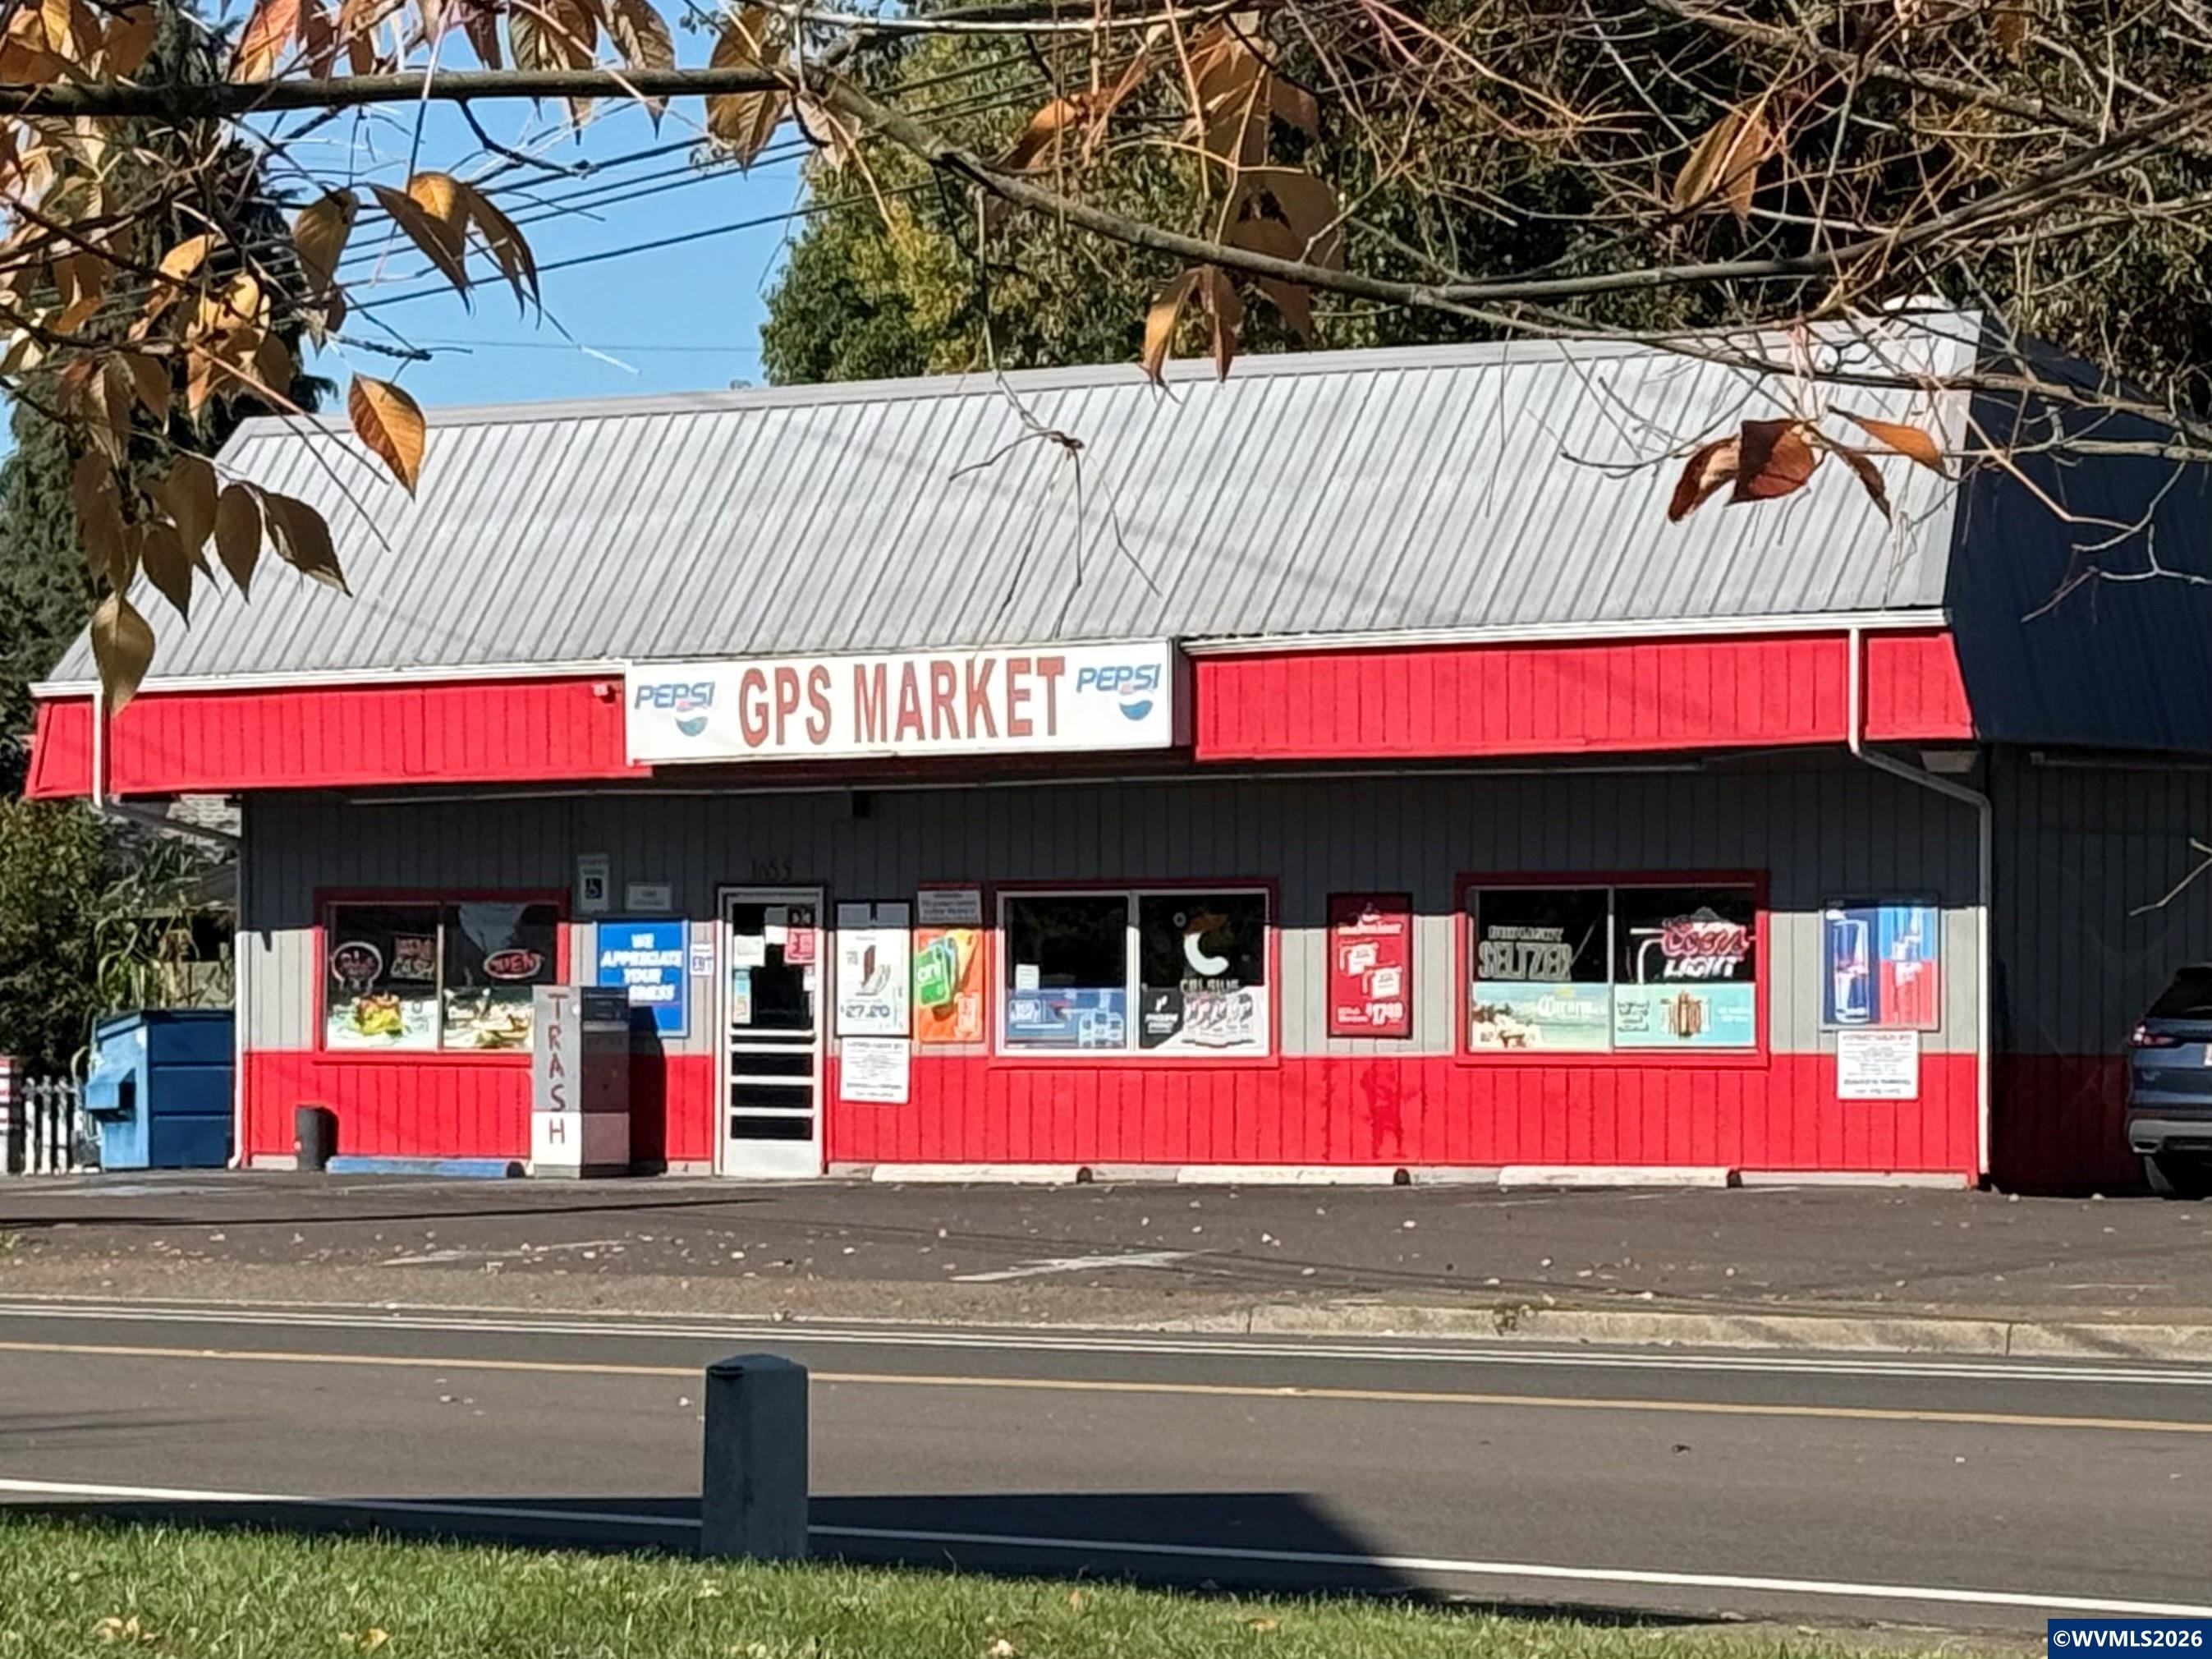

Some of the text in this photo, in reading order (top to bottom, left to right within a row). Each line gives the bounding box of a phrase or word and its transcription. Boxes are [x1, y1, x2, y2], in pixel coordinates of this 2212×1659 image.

[634, 681, 716, 710] PEPSI
[1076, 663, 1163, 694] PEPSI
[739, 656, 1066, 748] GPS MARKET
[1479, 940, 1573, 981] SELTZER
[1663, 955, 1741, 979] LIGHT
[548, 993, 569, 1145] TRASH
